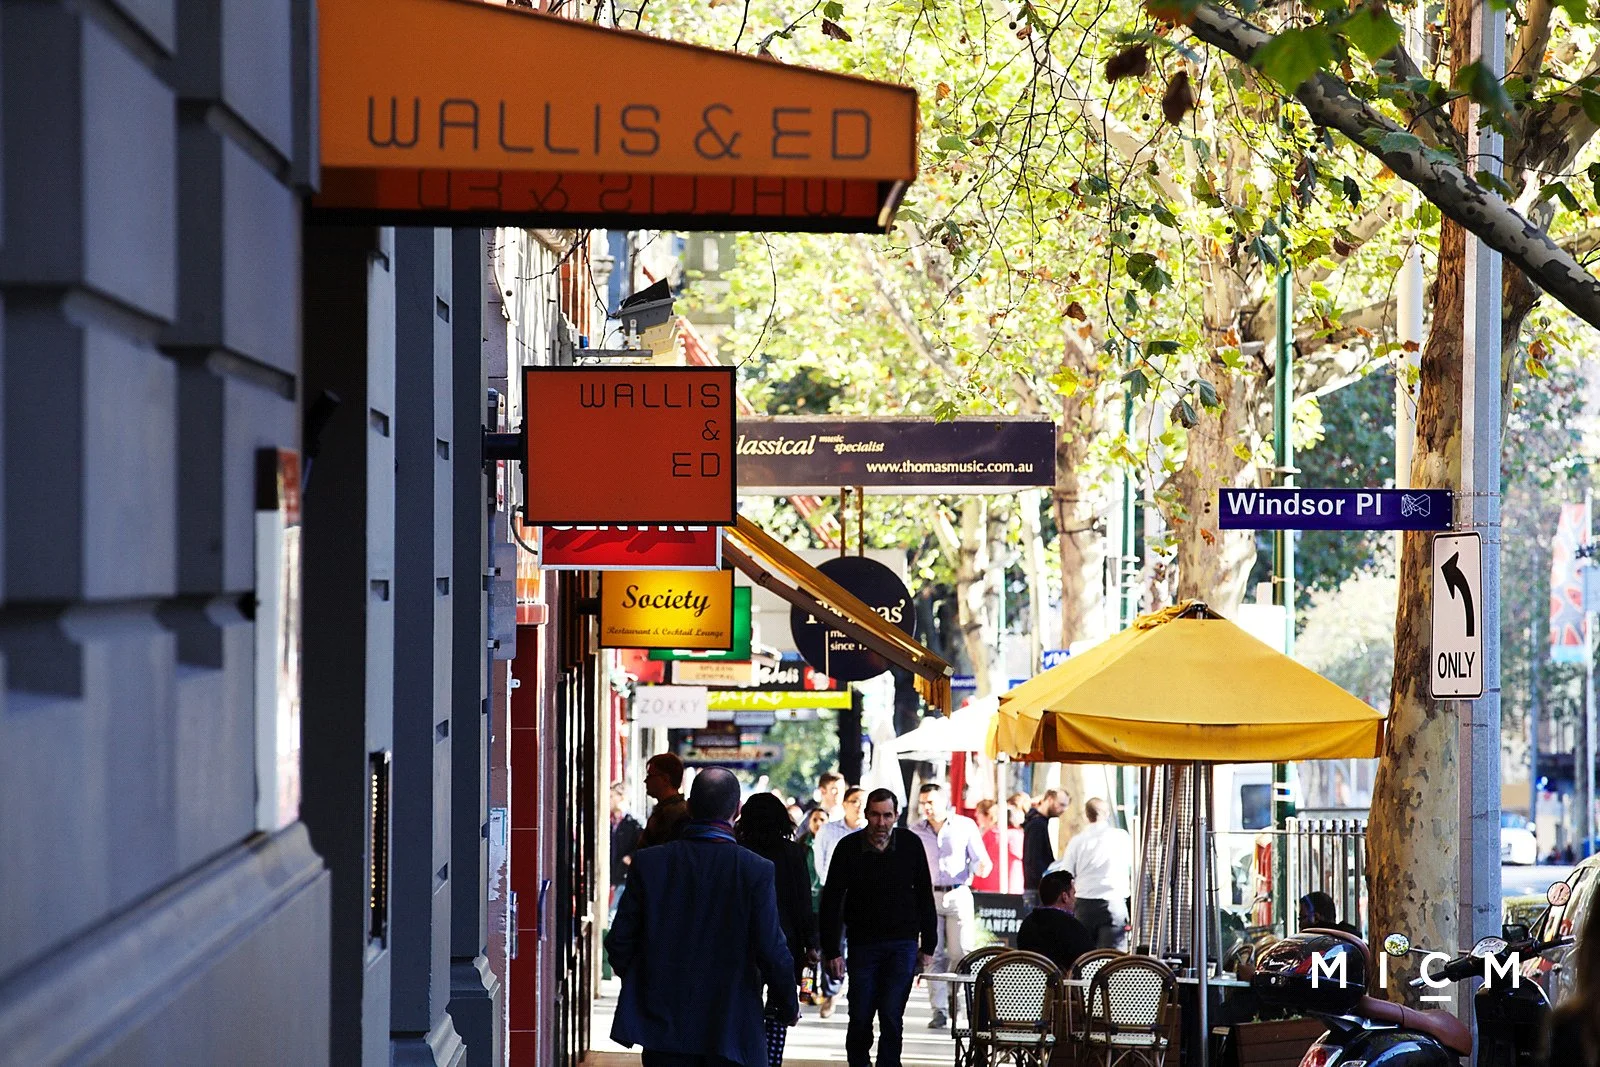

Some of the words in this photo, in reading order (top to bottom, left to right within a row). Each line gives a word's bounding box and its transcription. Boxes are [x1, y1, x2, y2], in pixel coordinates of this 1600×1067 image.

[367, 96, 661, 157] WALLIS
[693, 103, 742, 160] &
[771, 107, 872, 161] ED
[580, 383, 721, 408] WALLIS
[701, 419, 721, 441] &
[736, 435, 816, 455] lassical
[819, 435, 845, 443] music
[833, 441, 885, 455] specialist
[672, 452, 721, 478] ED
[866, 460, 1034, 473] www.thomasmusic.com.au
[1227, 492, 1346, 516] Windsor
[1356, 493, 1382, 516] Pl
[622, 584, 711, 618] Society
[607, 626, 651, 635] Restaurant
[662, 627, 693, 637] Cocktail
[695, 628, 724, 638] Lounge
[830, 641, 855, 651] since
[1437, 651, 1476, 679] ONLY
[640, 698, 700, 714] ZOKKY
